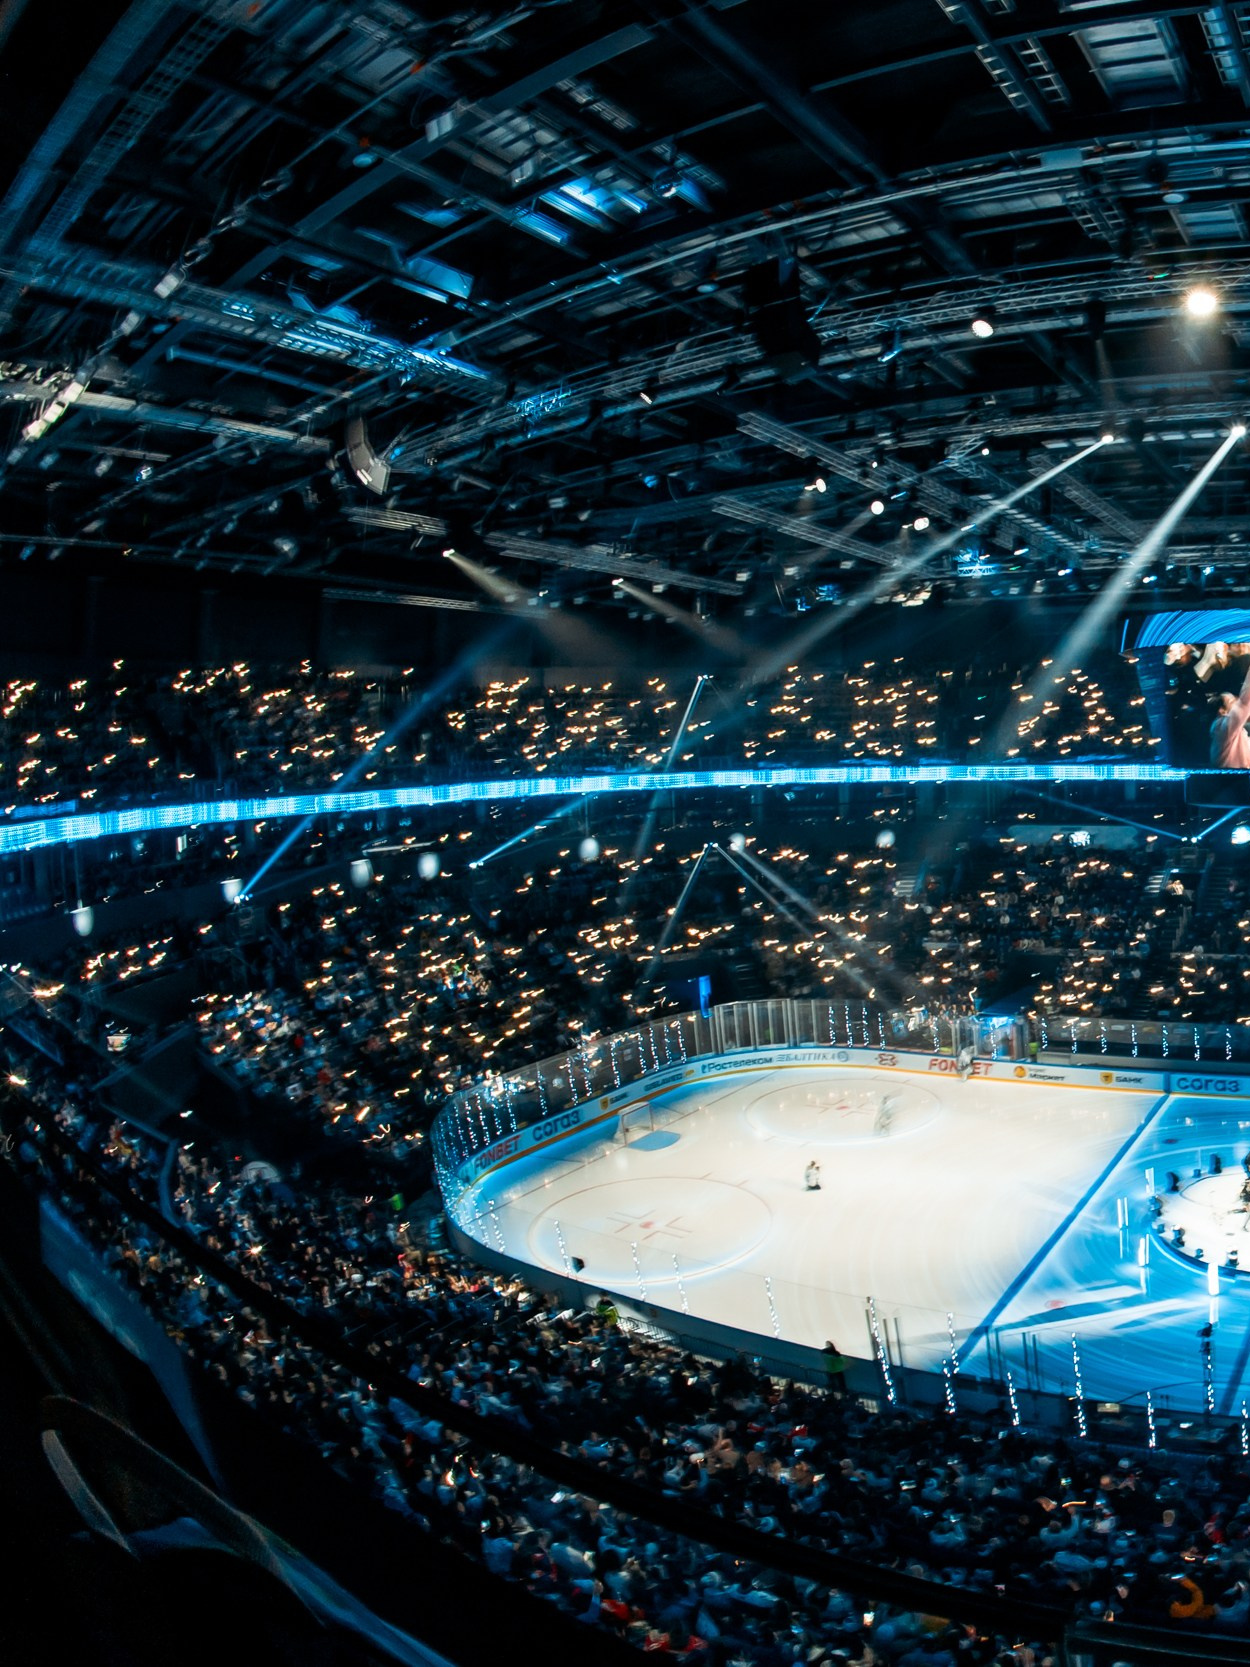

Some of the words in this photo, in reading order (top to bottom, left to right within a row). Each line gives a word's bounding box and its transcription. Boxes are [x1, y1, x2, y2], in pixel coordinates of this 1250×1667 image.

[708, 1057, 773, 1071] Ростелеком
[928, 1058, 993, 1076] FONET
[475, 1134, 520, 1175] FONBET
